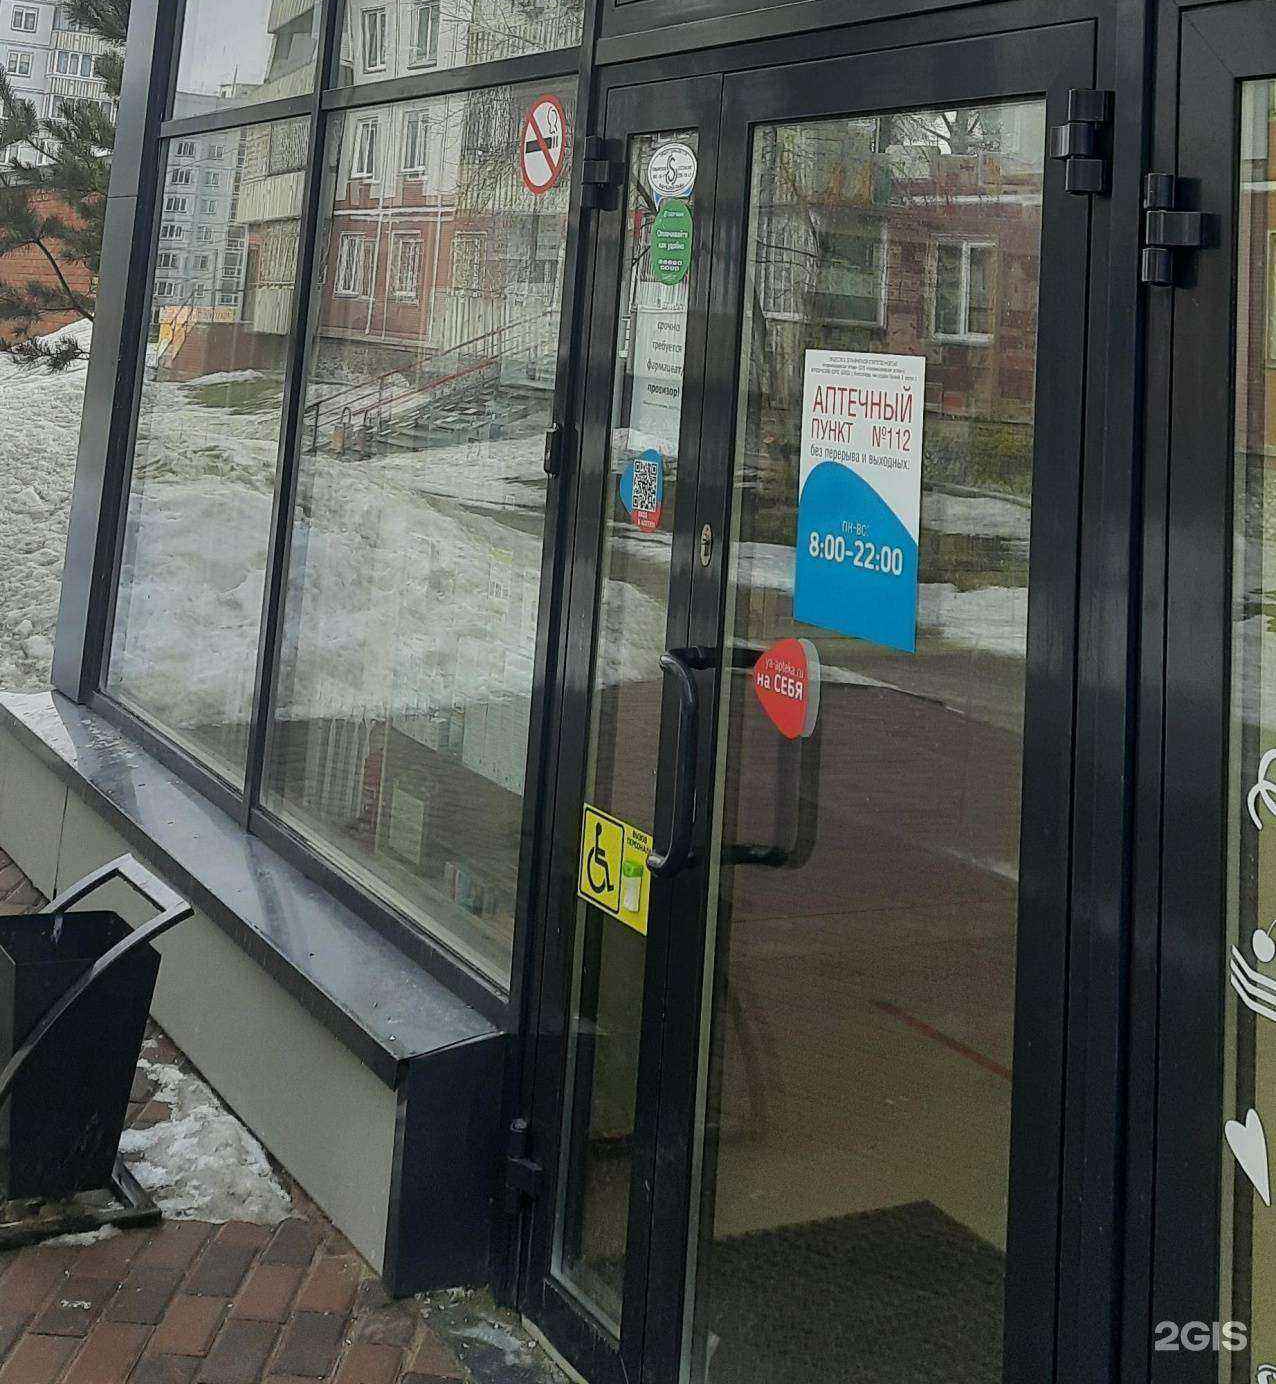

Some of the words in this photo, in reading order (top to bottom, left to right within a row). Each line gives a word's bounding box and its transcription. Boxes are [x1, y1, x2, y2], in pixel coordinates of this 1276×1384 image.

[813, 385, 913, 424] АПТЕЧНЫЙ
[811, 418, 854, 444] ПУНКТ
[810, 444, 823, 458] без
[824, 448, 860, 464] перерыва
[861, 453, 867, 464] и
[809, 531, 903, 576] 8:00-22:00
[757, 672, 771, 689] на
[774, 673, 803, 701] СЕБЯ
